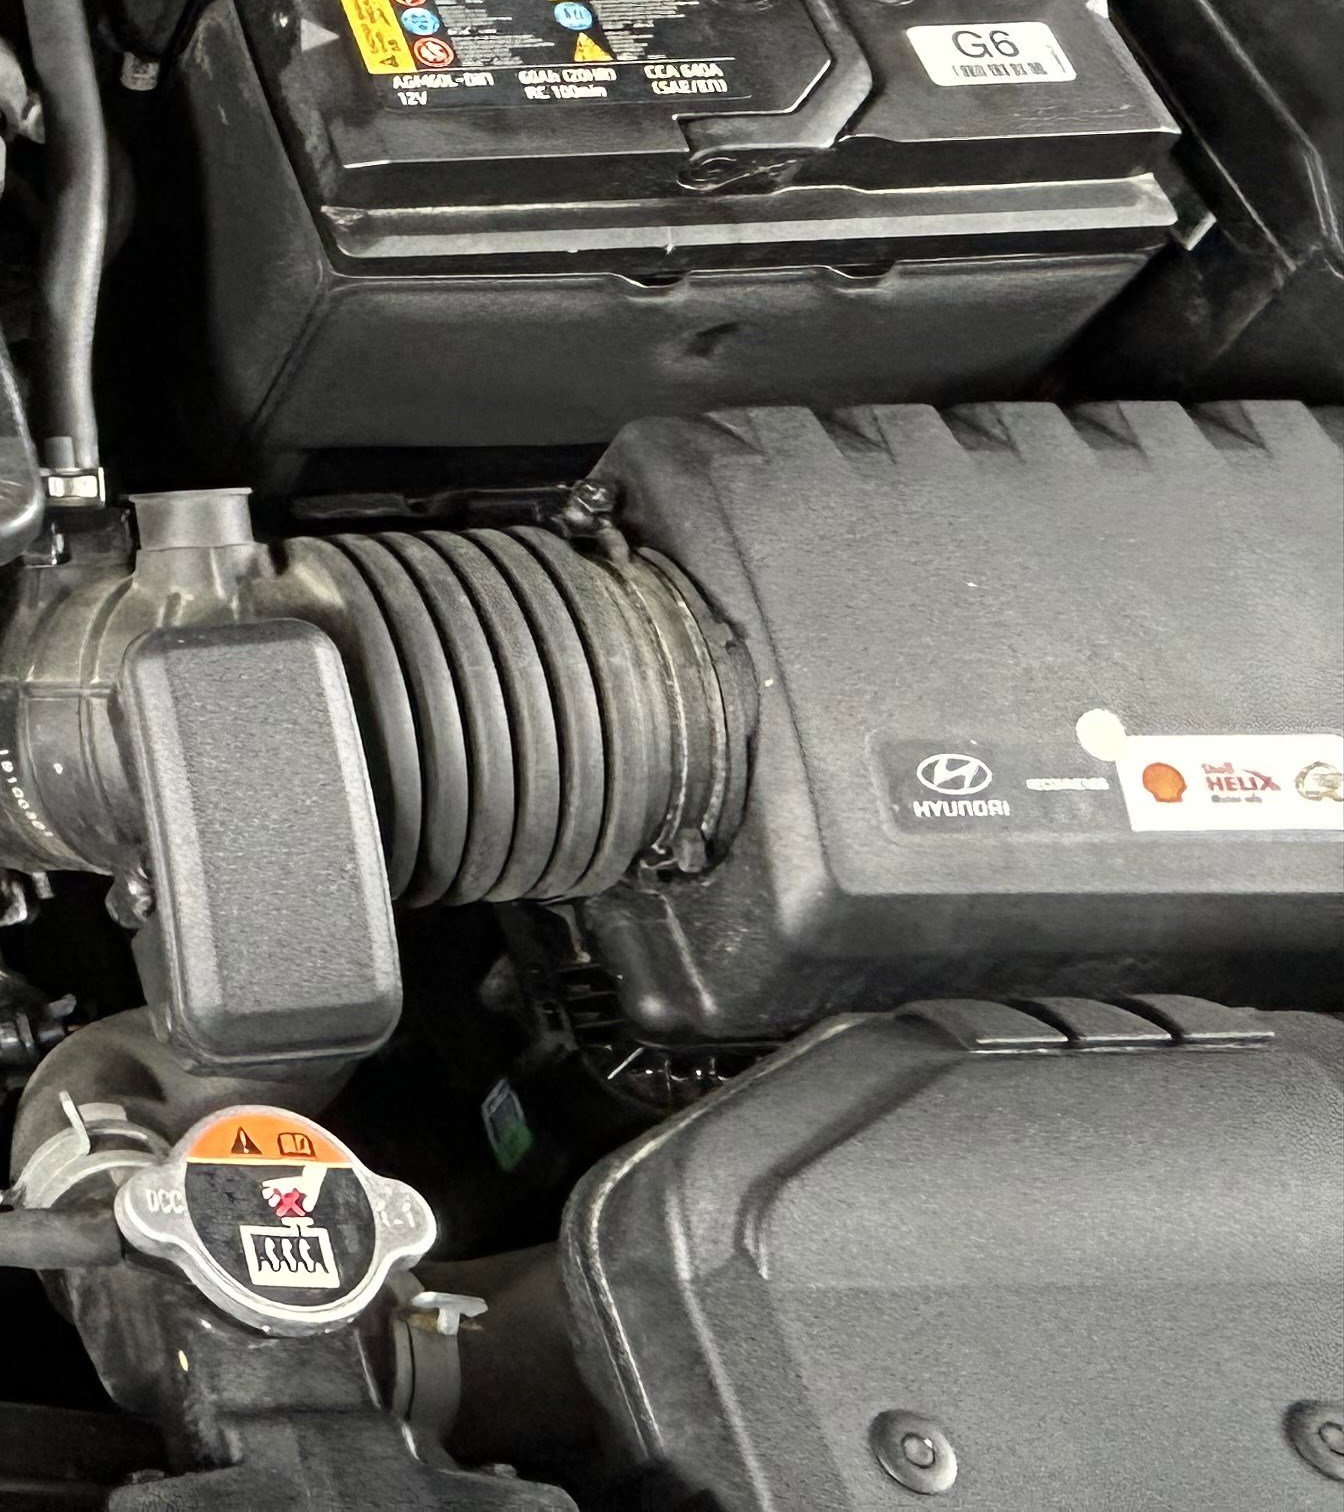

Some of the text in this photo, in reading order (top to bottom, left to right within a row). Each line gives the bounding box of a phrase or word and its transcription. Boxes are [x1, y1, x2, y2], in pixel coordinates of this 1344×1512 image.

[952, 30, 1020, 58] G6
[397, 91, 428, 106] 12V
[1205, 769, 1281, 792] HELIX
[913, 800, 1011, 818] HYUNDAI
